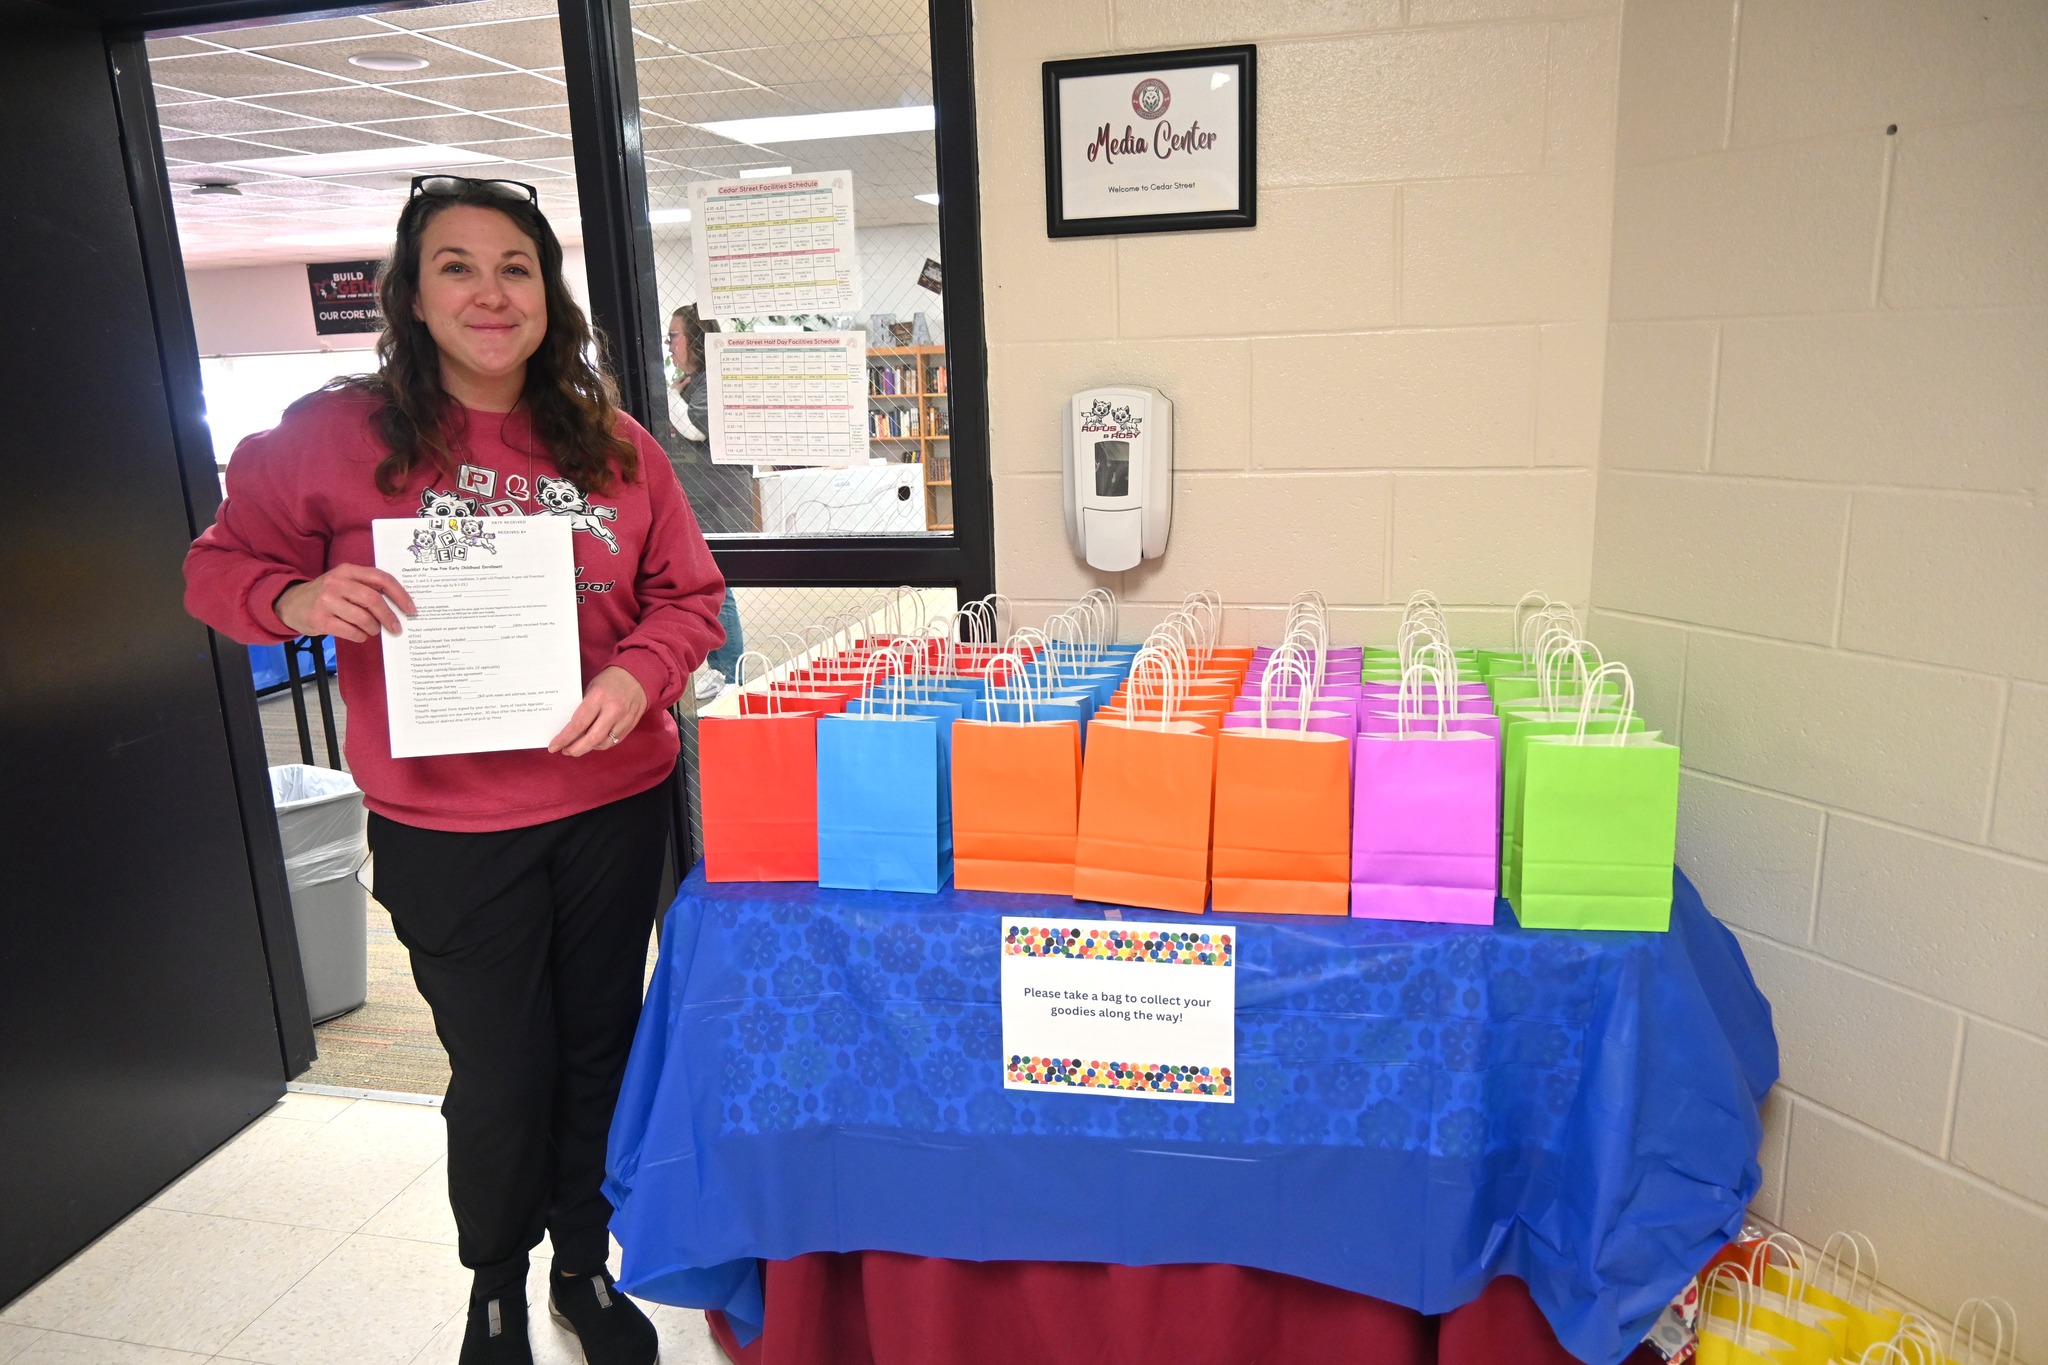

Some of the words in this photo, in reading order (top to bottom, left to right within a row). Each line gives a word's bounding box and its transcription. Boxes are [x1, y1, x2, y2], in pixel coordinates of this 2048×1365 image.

[1087, 122, 1148, 164] Media
[1153, 120, 1217, 160] Center
[759, 183, 788, 192] Facilities
[788, 181, 818, 189] Schedule
[1108, 185, 1140, 193] Welcome
[1150, 182, 1173, 191] Cedar
[1174, 182, 1196, 190] Street
[332, 272, 364, 282] BUILD
[320, 312, 339, 320] OUR
[340, 310, 365, 320] CORE
[466, 472, 489, 488] P
[1024, 987, 1061, 1000] Please
[1064, 990, 1089, 1000] take
[1091, 992, 1098, 1001] a
[1101, 992, 1122, 1005] bag
[1125, 994, 1137, 1003] to
[1140, 994, 1181, 1006] collect
[1184, 998, 1212, 1008] your
[1050, 1006, 1096, 1017] goodies
[1098, 1008, 1131, 1021] along
[1134, 1010, 1154, 1021] the
[1156, 1012, 1183, 1024] way!
